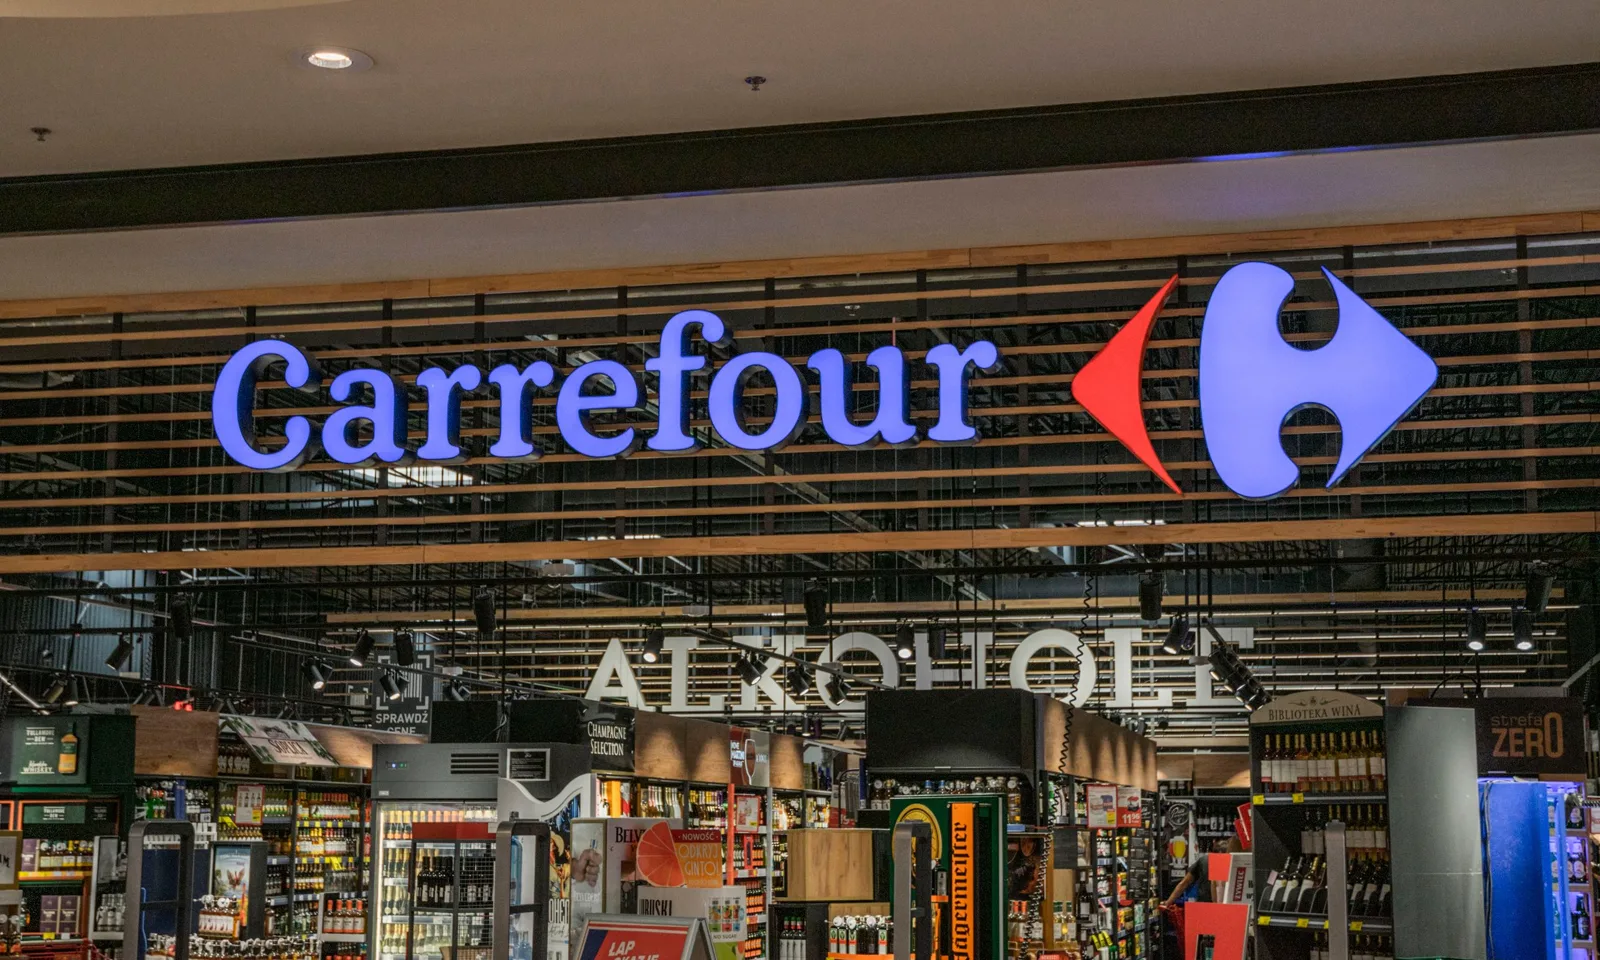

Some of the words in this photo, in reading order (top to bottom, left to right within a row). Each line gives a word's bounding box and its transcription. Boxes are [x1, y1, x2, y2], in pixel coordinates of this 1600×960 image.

[211, 309, 998, 469] Carrefour
[375, 710, 429, 724] SPRAWDŹ
[1268, 708, 1328, 721] BIBLIOTEKA
[1331, 704, 1361, 717] WINA
[1491, 713, 1543, 727] strefa
[590, 740, 625, 756] SELECTION
[682, 832, 715, 841] NOWOŚĆ
[678, 843, 719, 859] ODKRYJ
[608, 940, 636, 957] ŁAP
